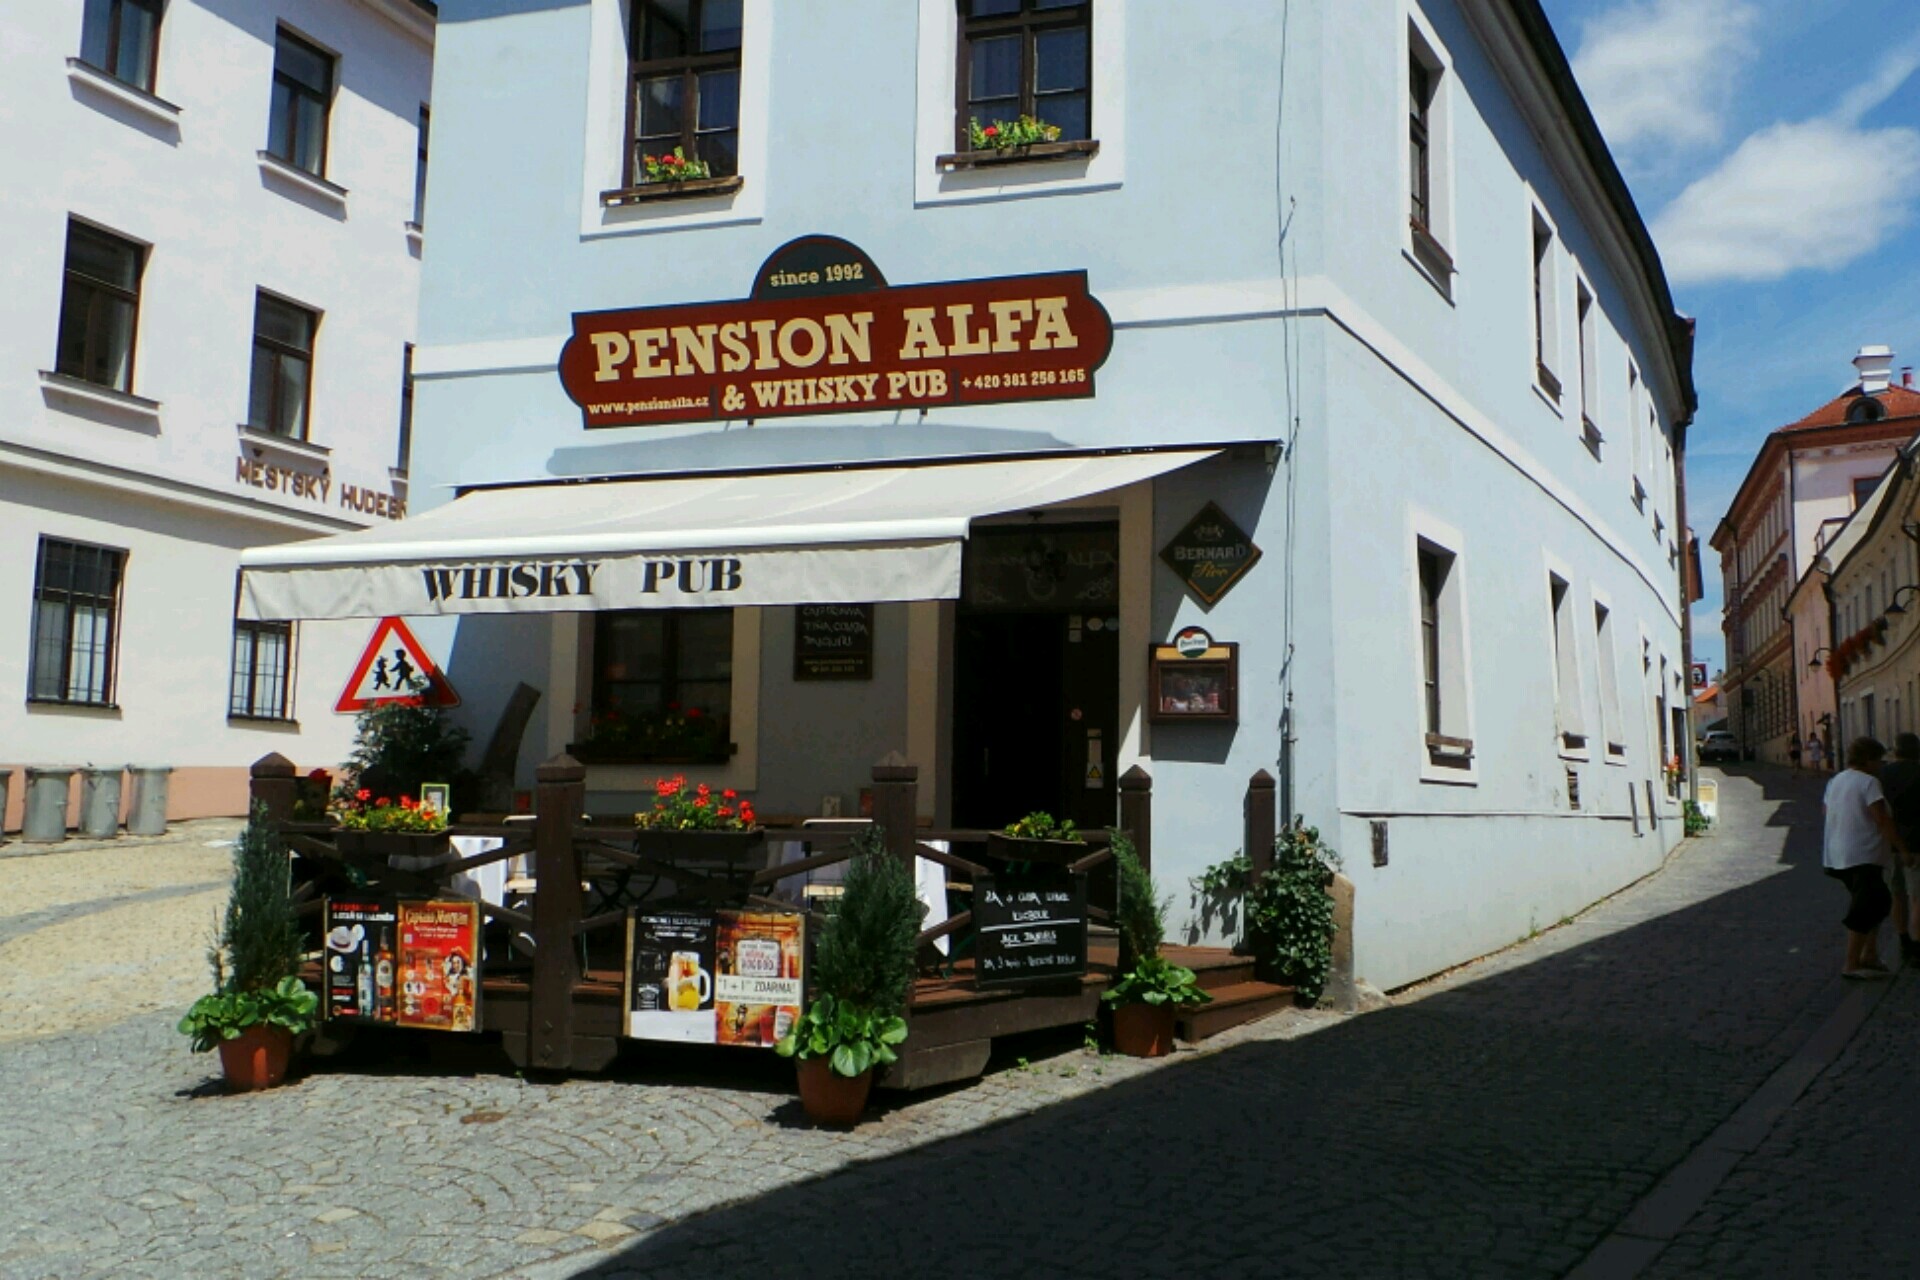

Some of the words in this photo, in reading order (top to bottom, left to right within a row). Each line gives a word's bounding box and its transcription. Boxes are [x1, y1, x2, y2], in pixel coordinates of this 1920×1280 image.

[769, 269, 820, 287] since
[825, 262, 864, 282] 1992
[590, 311, 874, 381] PENSION
[899, 296, 1079, 360] ALFA
[721, 384, 747, 411] &
[750, 373, 880, 408] WHISKY
[886, 369, 949, 399] PUB
[1003, 373, 1029, 388] 381
[1031, 370, 1057, 386] 256
[1059, 368, 1086, 384] 165
[1173, 542, 1246, 562] BERNARD
[421, 562, 600, 602] WHISKY
[640, 557, 744, 594] PUB
